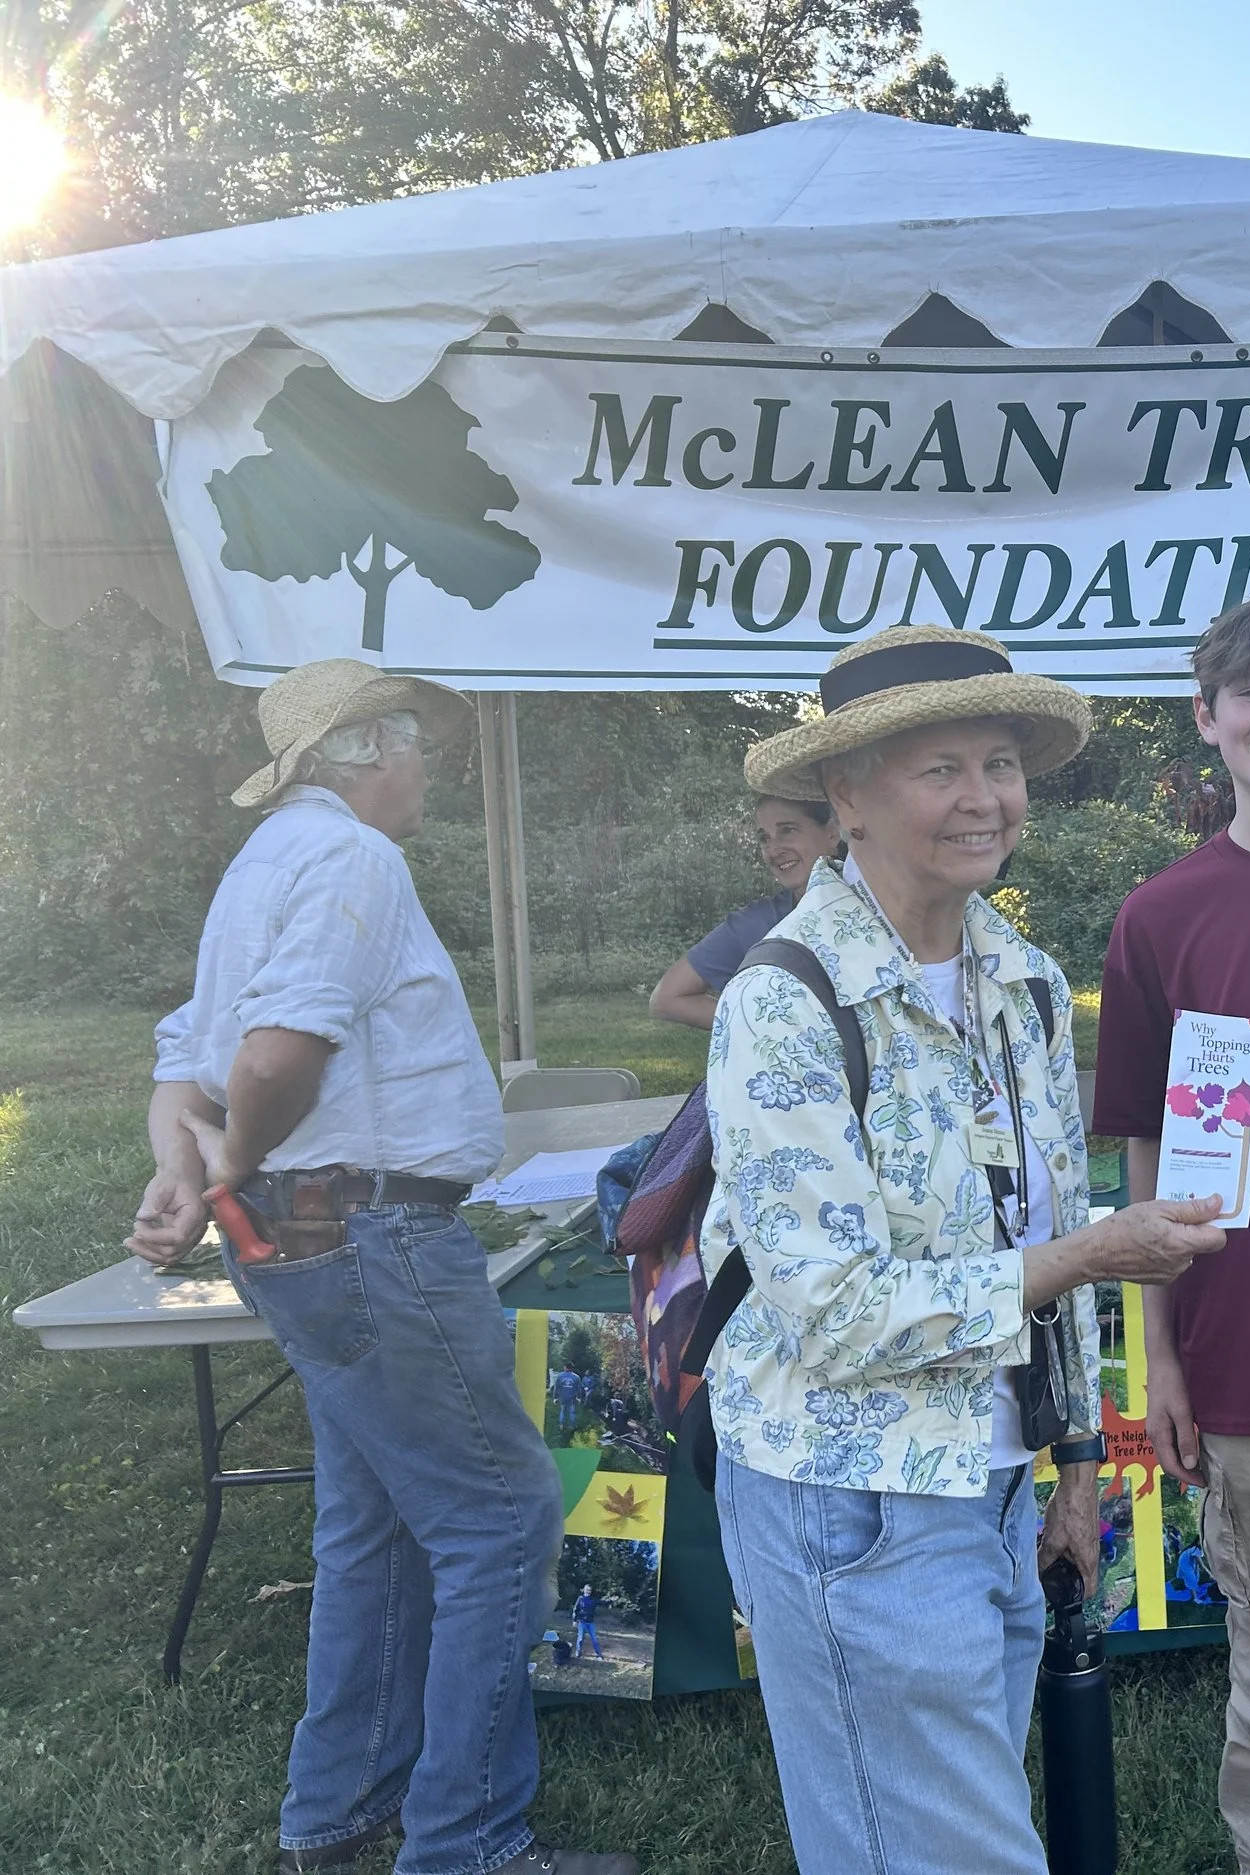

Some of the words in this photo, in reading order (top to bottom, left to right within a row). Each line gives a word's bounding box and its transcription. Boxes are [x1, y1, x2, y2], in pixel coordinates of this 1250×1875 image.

[572, 392, 1086, 494] McLEAN
[1190, 1021, 1216, 1038] Why
[1198, 1034, 1250, 1055] Topping
[1202, 1050, 1235, 1064] Hurts
[1186, 1056, 1230, 1076] Trees
[1105, 1431, 1119, 1443] he
[1114, 1445, 1134, 1457] Tree
